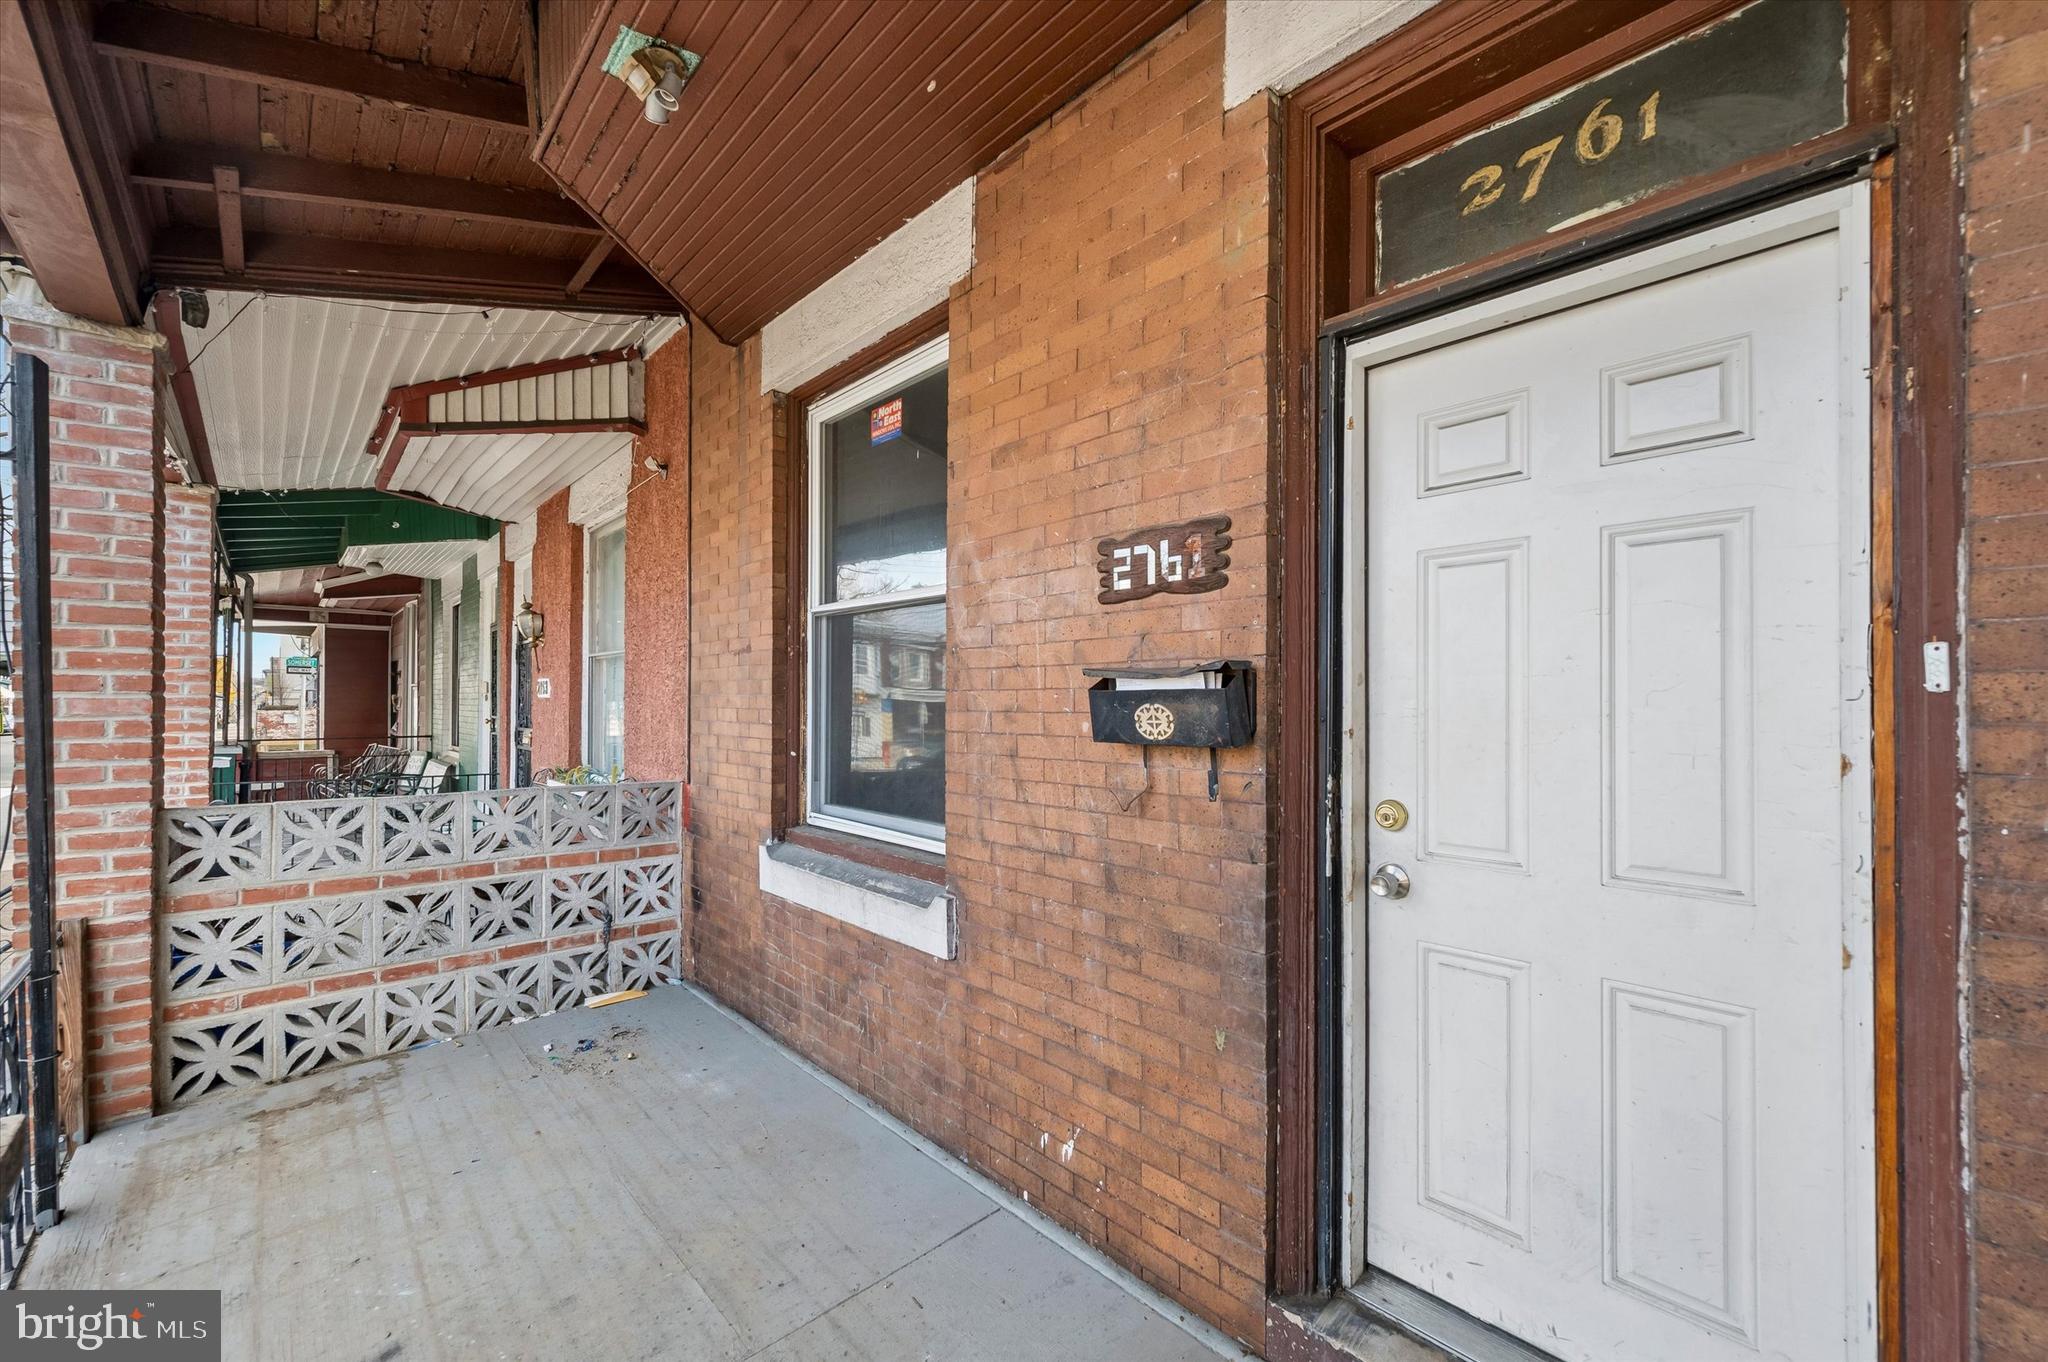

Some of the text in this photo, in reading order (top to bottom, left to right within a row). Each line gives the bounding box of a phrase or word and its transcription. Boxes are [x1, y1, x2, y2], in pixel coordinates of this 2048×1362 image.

[1459, 90, 1660, 217] 2761
[878, 400, 902, 419] North
[884, 411, 902, 427] East
[1113, 533, 1205, 590] 2761
[288, 659, 316, 667] SOMERSET
